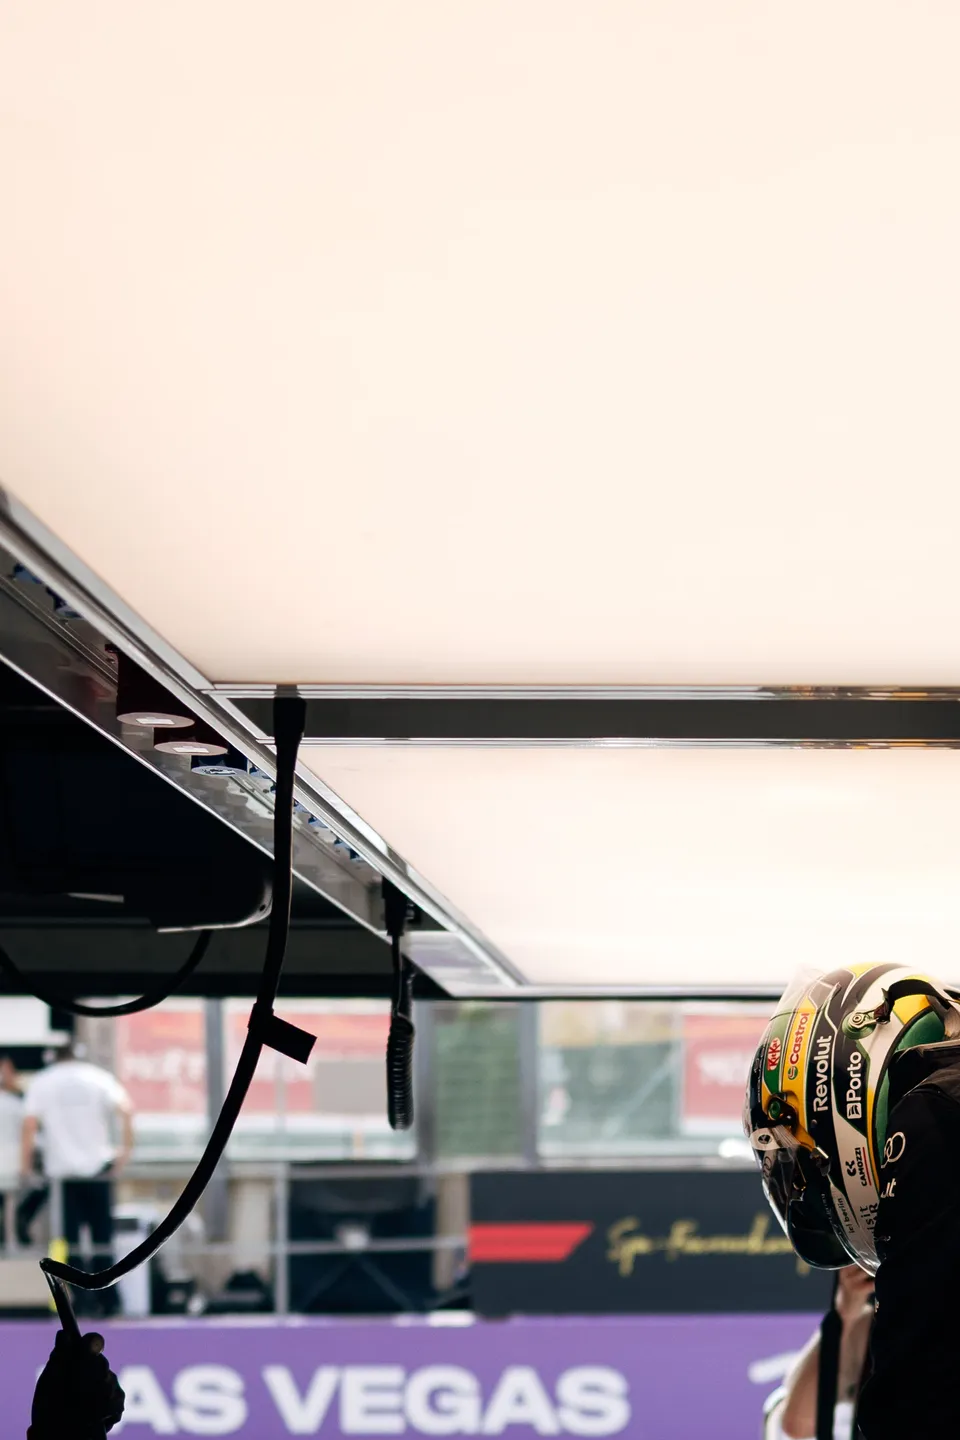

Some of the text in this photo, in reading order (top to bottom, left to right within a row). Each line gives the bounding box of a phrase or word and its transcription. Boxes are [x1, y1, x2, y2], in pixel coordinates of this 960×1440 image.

[789, 1013, 810, 1065] Castrol
[813, 1036, 832, 1112] Revolut
[846, 1051, 862, 1102] Porto
[855, 1147, 867, 1187] CAMOZZI
[261, 1364, 631, 1436] VEGAS
